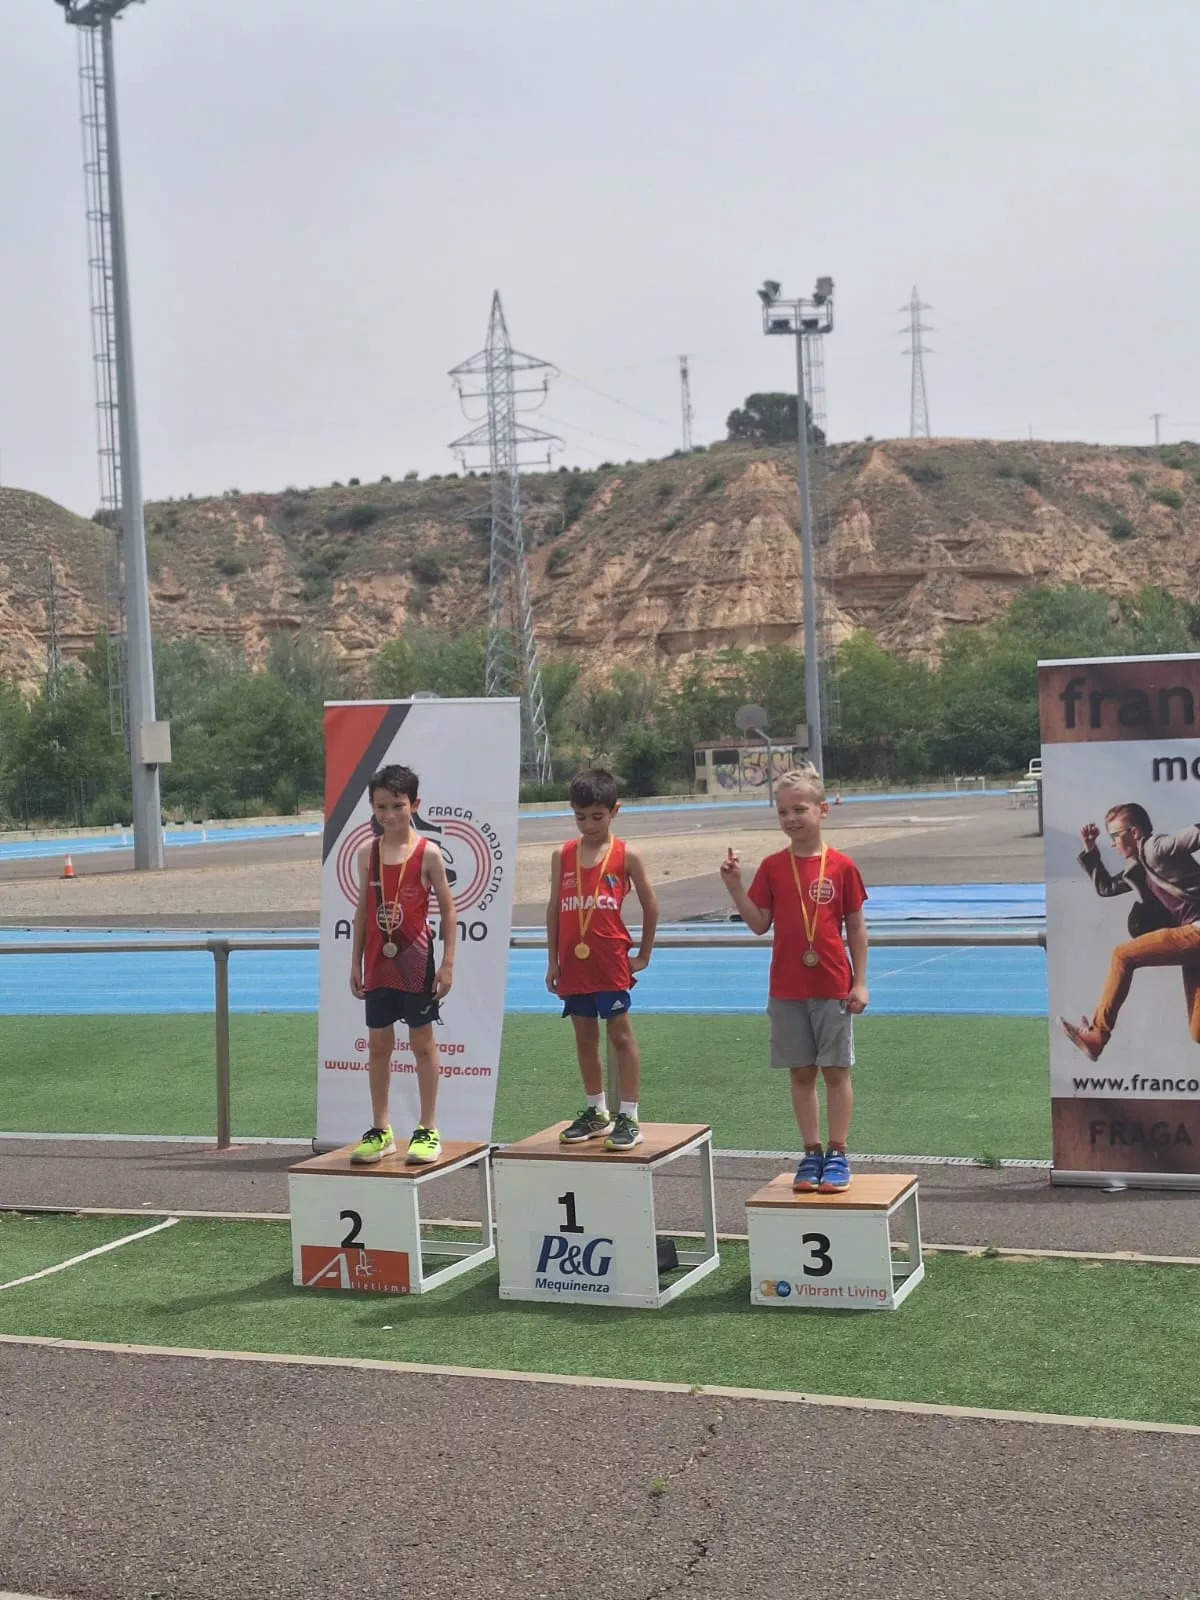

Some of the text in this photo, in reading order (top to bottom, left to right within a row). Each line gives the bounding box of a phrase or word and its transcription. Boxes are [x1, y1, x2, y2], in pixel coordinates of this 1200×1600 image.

[428, 806, 473, 820] FRAGA
[481, 823, 503, 860] BAJO
[1089, 1120, 1193, 1147] FRAGA
[340, 1210, 365, 1249] 2
[557, 1192, 584, 1233] 1
[536, 1235, 613, 1277] P&G
[802, 1232, 833, 1276] 3
[535, 1278, 610, 1293] Mequinenza
[795, 1284, 843, 1297] Vibrant
[848, 1286, 887, 1300] Living
